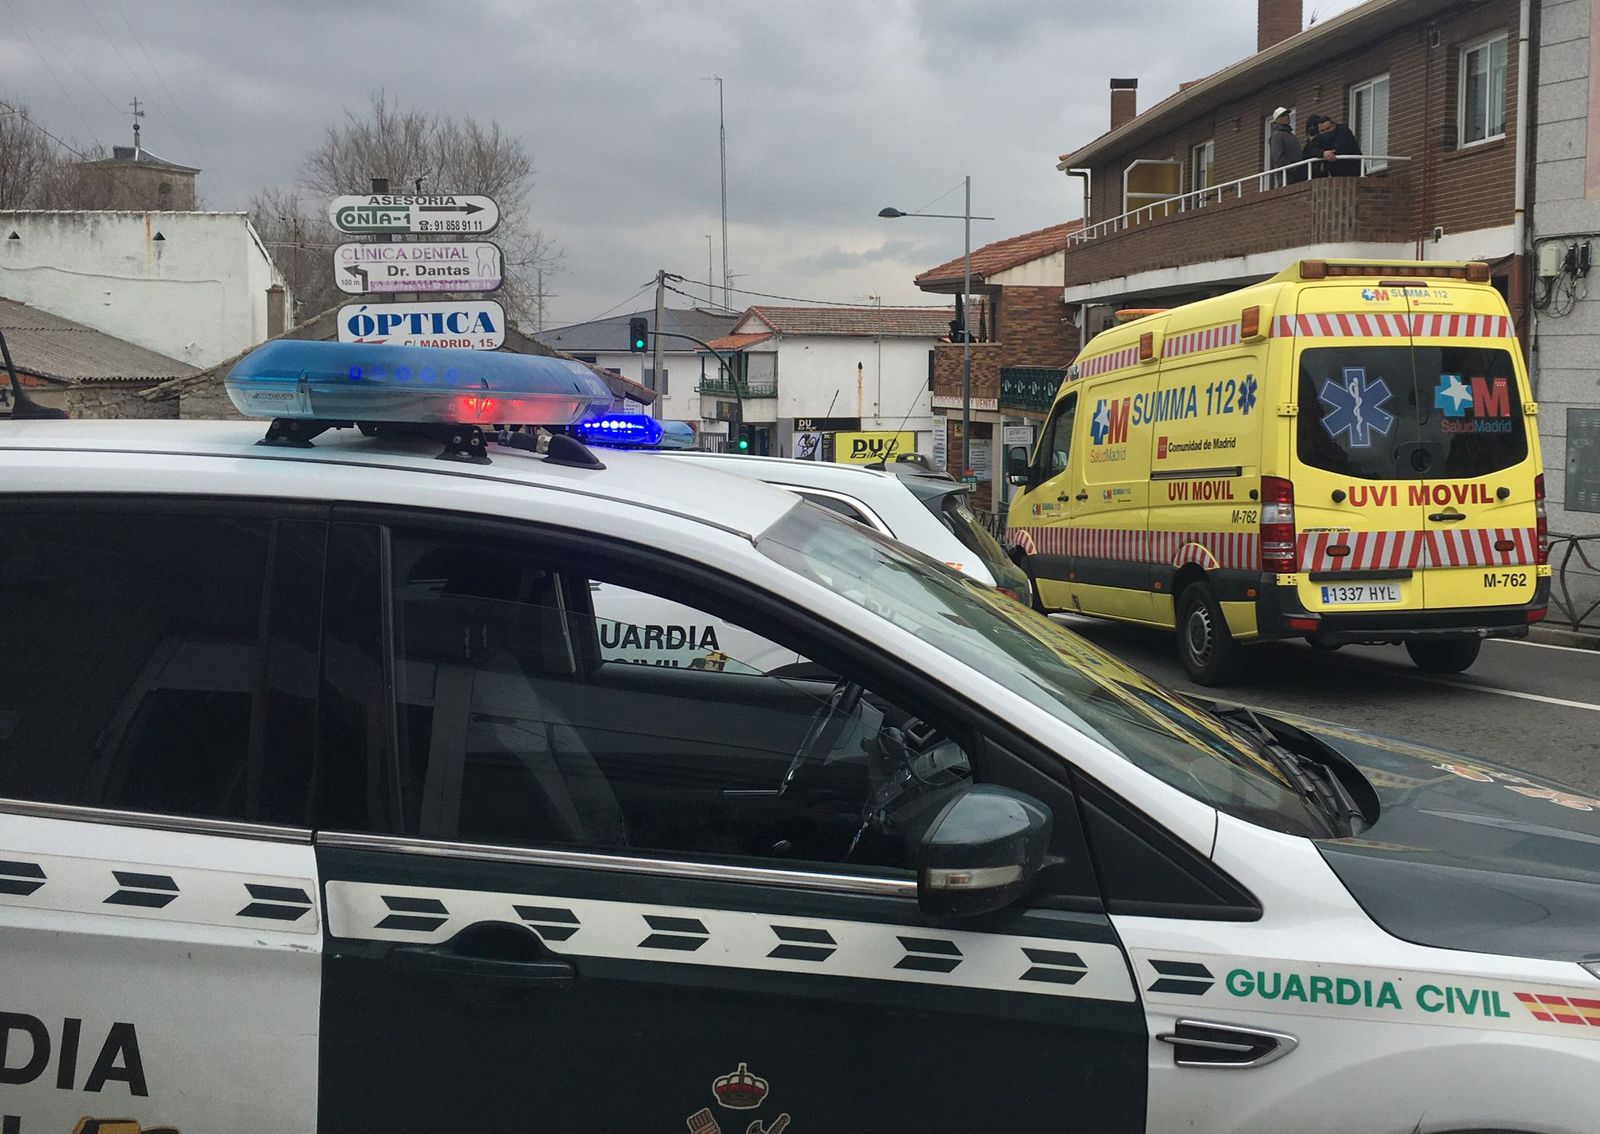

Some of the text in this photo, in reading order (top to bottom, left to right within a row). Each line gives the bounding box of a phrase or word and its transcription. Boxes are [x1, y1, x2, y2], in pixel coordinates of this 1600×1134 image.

[434, 220, 483, 231] 91 858 91 11
[341, 244, 469, 260] CLÍNICA DENTAL
[387, 264, 470, 277] Dr. Dantas
[1390, 288, 1449, 299] SUMMA 112
[347, 305, 497, 337] ÓPTICA
[420, 339, 475, 349] MADRID,
[479, 338, 498, 348] 15.
[1131, 378, 1237, 426] SUMMA 112
[1441, 419, 1513, 433] SaludMadrid
[1168, 439, 1203, 453] Comunidad
[1203, 439, 1212, 450] de
[1213, 437, 1237, 450] Madrid
[1168, 480, 1234, 501] UVI MOVIL
[1348, 483, 1495, 507] UVI MOVIL
[1231, 509, 1257, 524] M-762
[1483, 573, 1527, 588] M-762
[1332, 586, 1396, 602] 1337 HYL
[600, 622, 720, 651] UARDIA
[1225, 968, 1511, 1018] GUARDIA CIVIL
[0, 1011, 150, 1097] DIA
